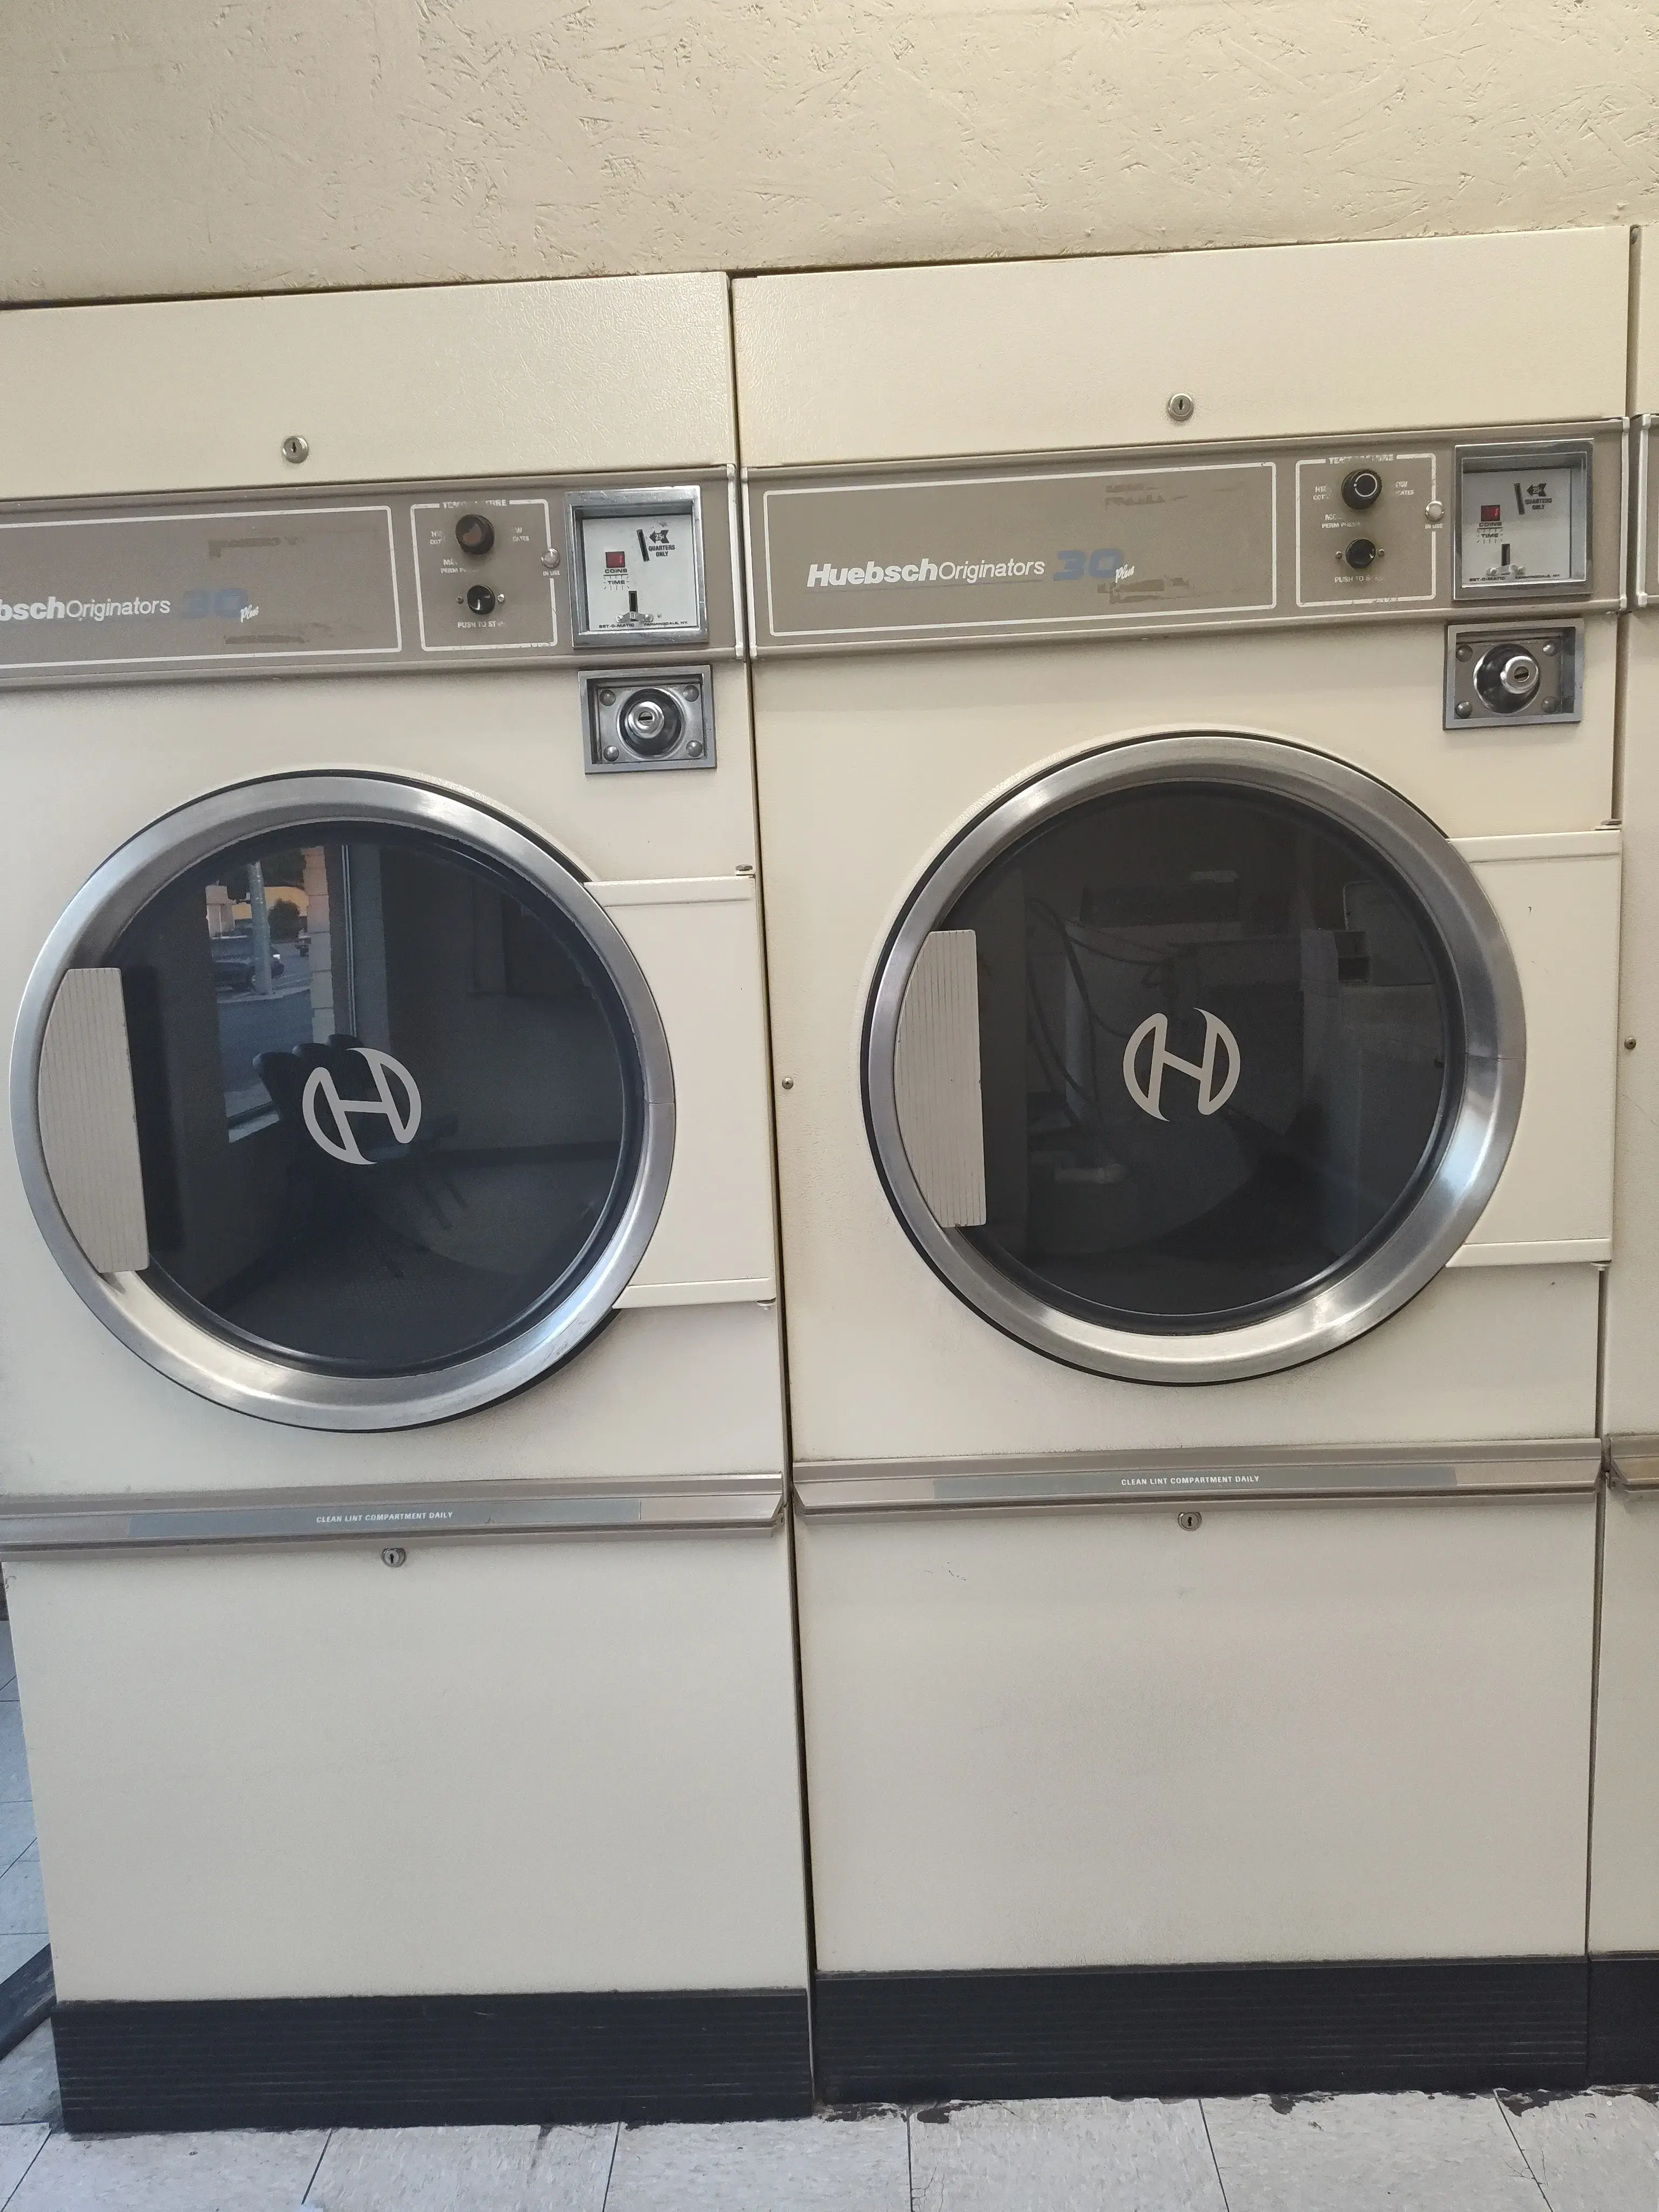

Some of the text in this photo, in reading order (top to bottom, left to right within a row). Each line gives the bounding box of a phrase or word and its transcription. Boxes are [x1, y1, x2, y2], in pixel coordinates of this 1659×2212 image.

[1053, 548, 1124, 581] 30
[1170, 1475, 1232, 1485] COMPARTMENT
[316, 1515, 342, 1523] CLEAN
[365, 1512, 427, 1521] COMPARTMENT
